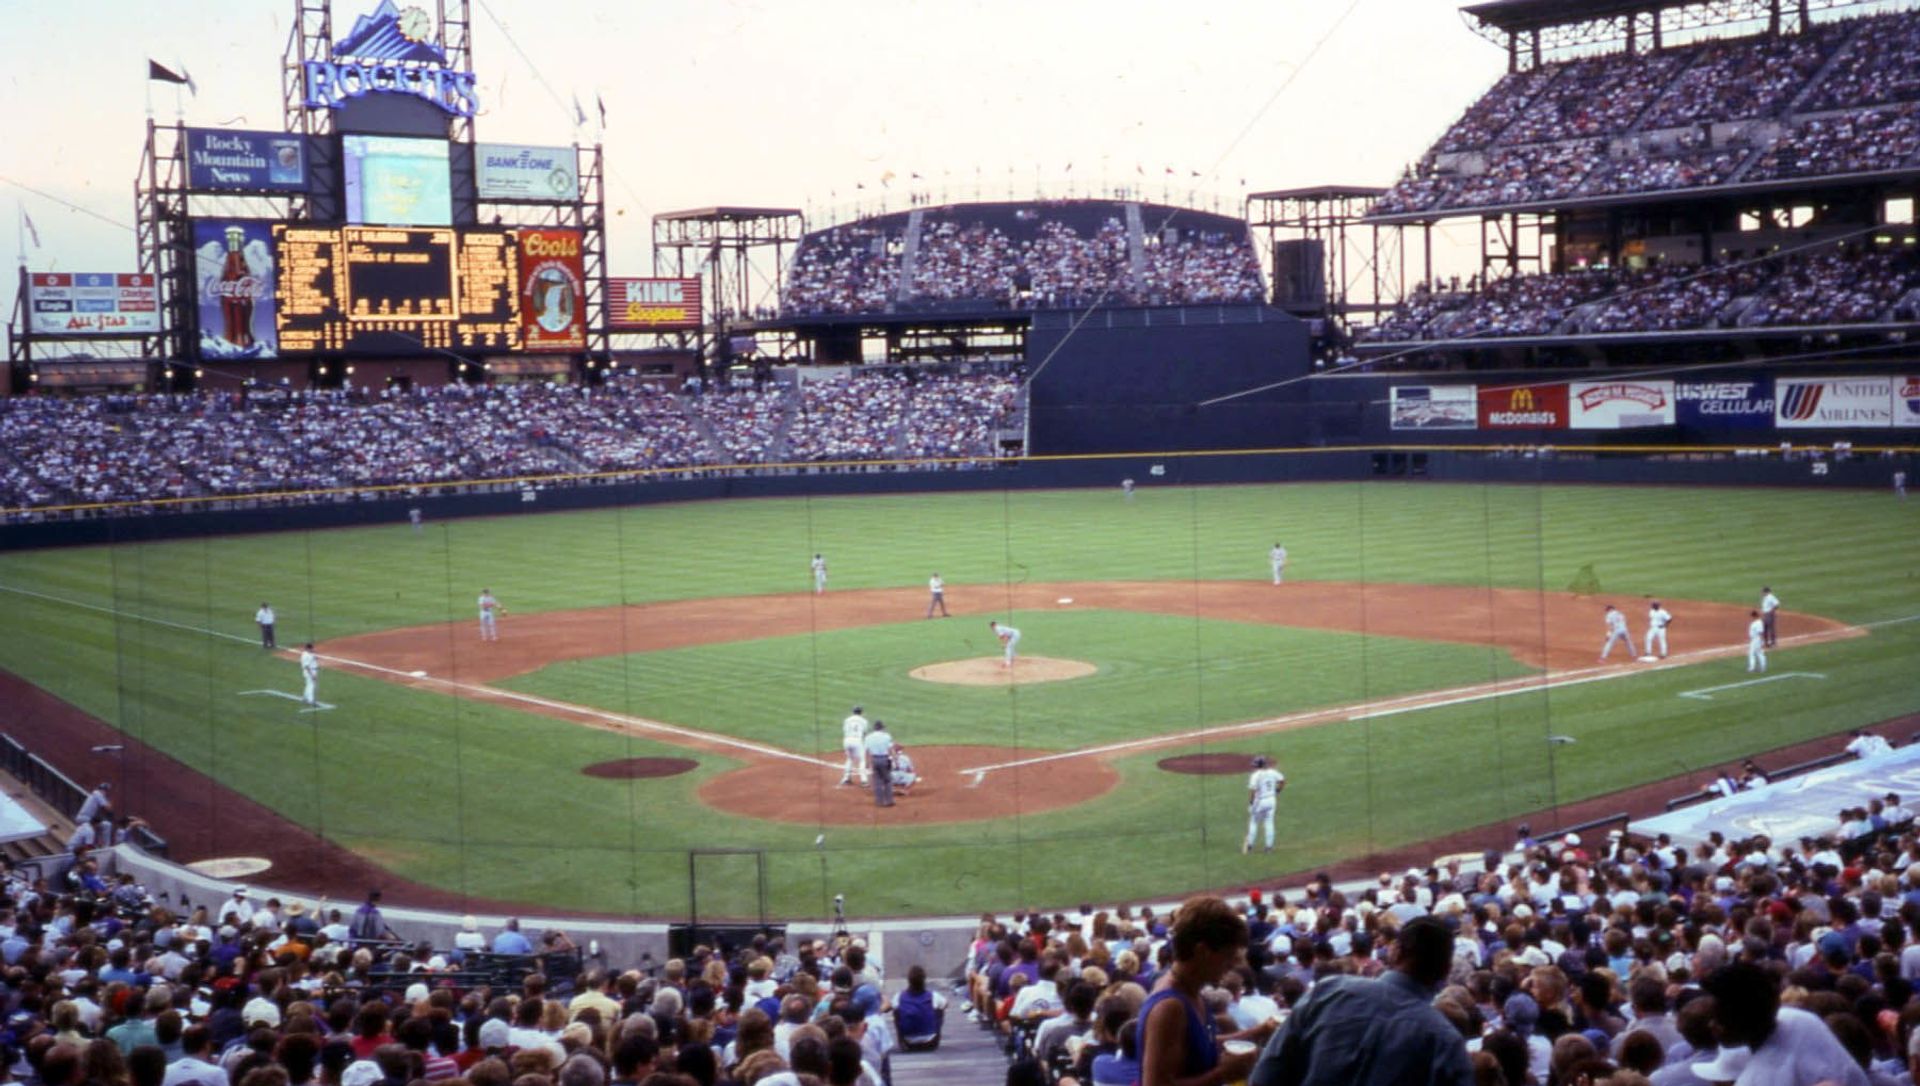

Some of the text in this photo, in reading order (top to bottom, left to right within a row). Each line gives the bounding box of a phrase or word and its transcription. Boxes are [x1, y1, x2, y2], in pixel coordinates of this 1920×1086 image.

[303, 60, 480, 118] ROCKIES
[205, 134, 252, 156] Rocky
[193, 150, 266, 169] Mountain
[486, 156, 553, 171] BANK ONE
[210, 167, 251, 182] News
[523, 233, 579, 257] Coors
[206, 275, 265, 300] Coca-Cola
[626, 281, 684, 303] KING
[626, 303, 688, 325] Soopers
[462, 333, 473, 346] 2
[485, 333, 496, 346] 2
[506, 334, 517, 346] 2
[1831, 384, 1889, 397] UNITED
[1700, 400, 1775, 414] CELLULAR
[1820, 408, 1889, 421] AIRLINES
[1488, 411, 1557, 425] McDonald's
